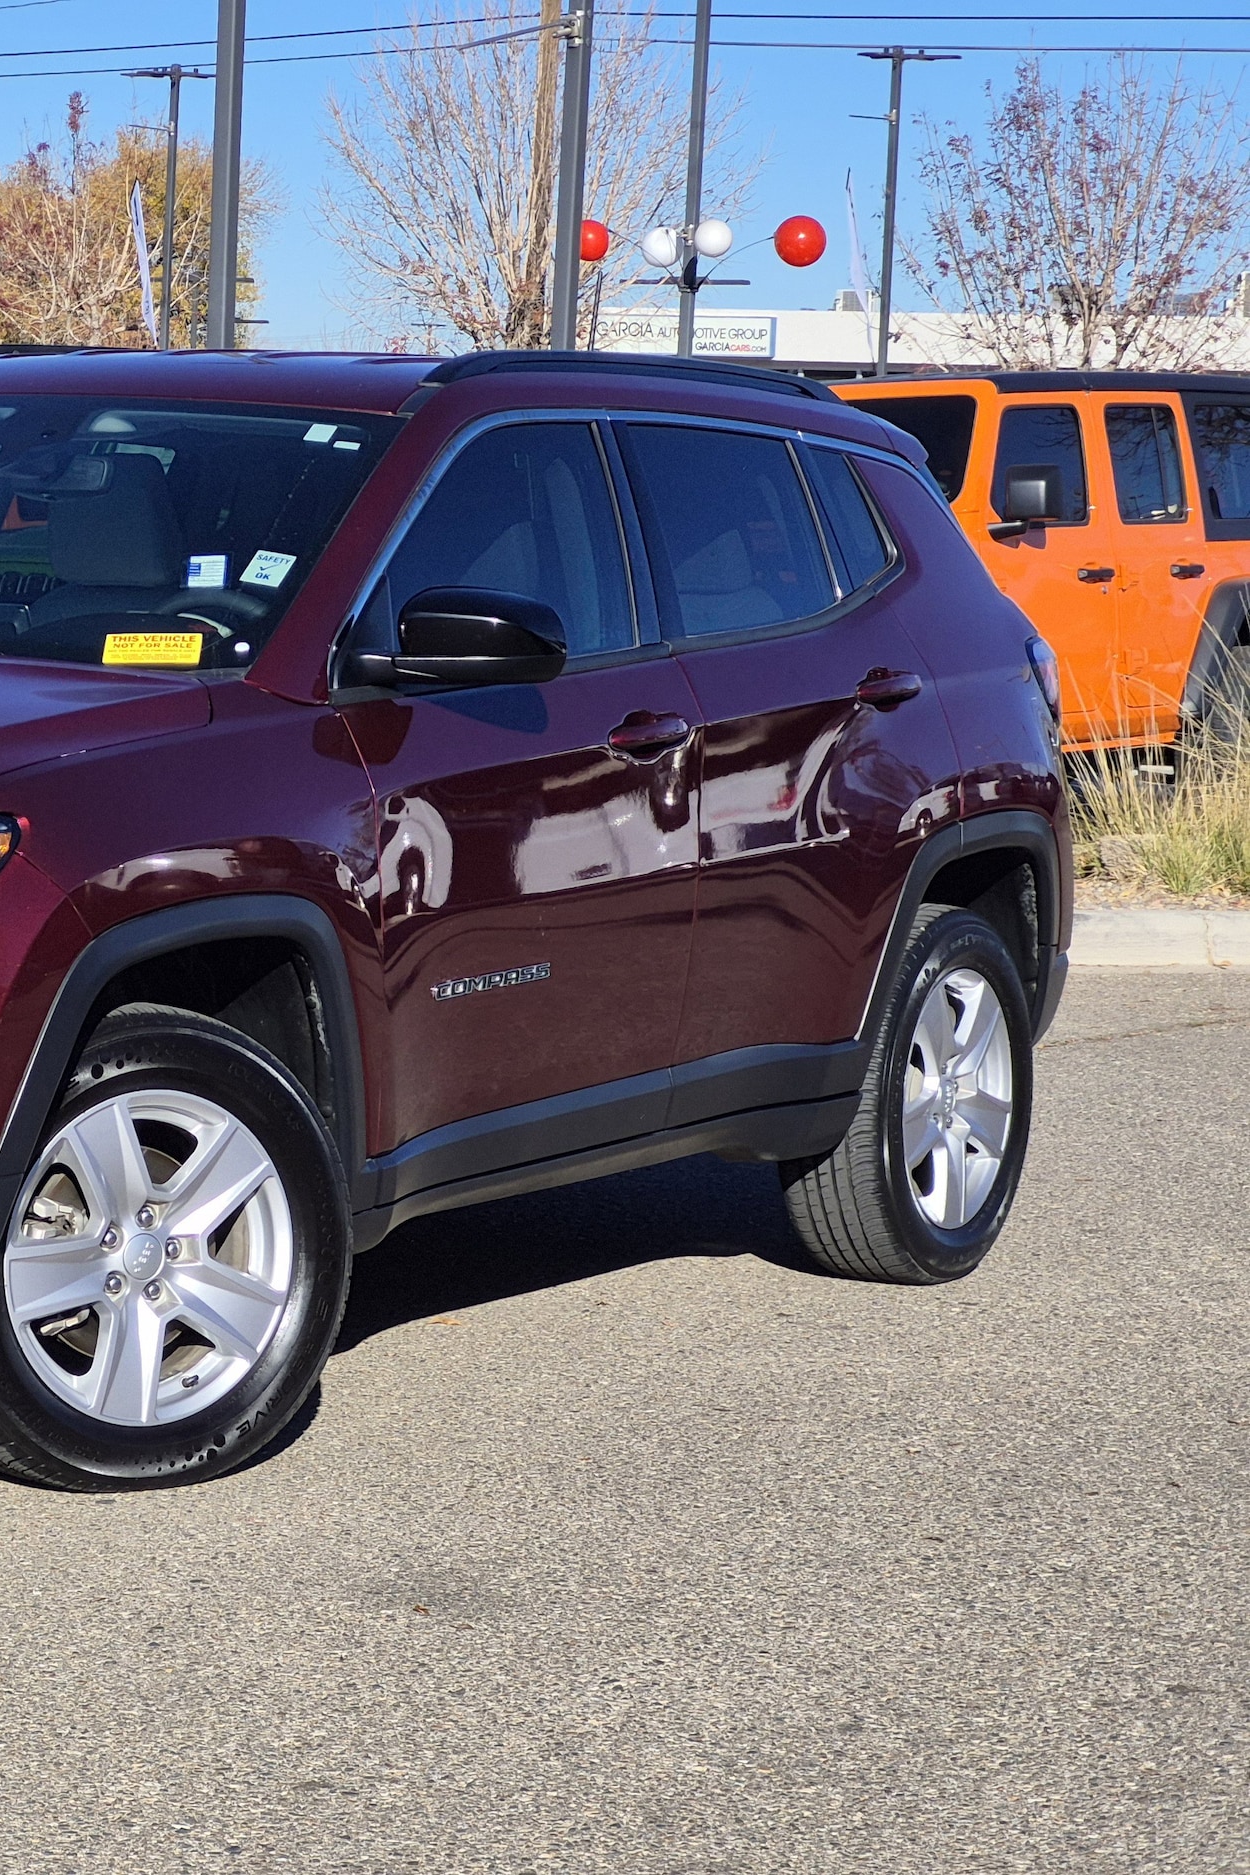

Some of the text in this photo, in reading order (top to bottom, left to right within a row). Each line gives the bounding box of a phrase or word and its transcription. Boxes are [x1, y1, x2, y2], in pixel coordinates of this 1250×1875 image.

[596, 321, 768, 340] GARCIA AUTOTIVE GROUP
[256, 553, 292, 565] SAFETY
[255, 572, 271, 580] OK
[434, 962, 551, 1001] COMPASS
